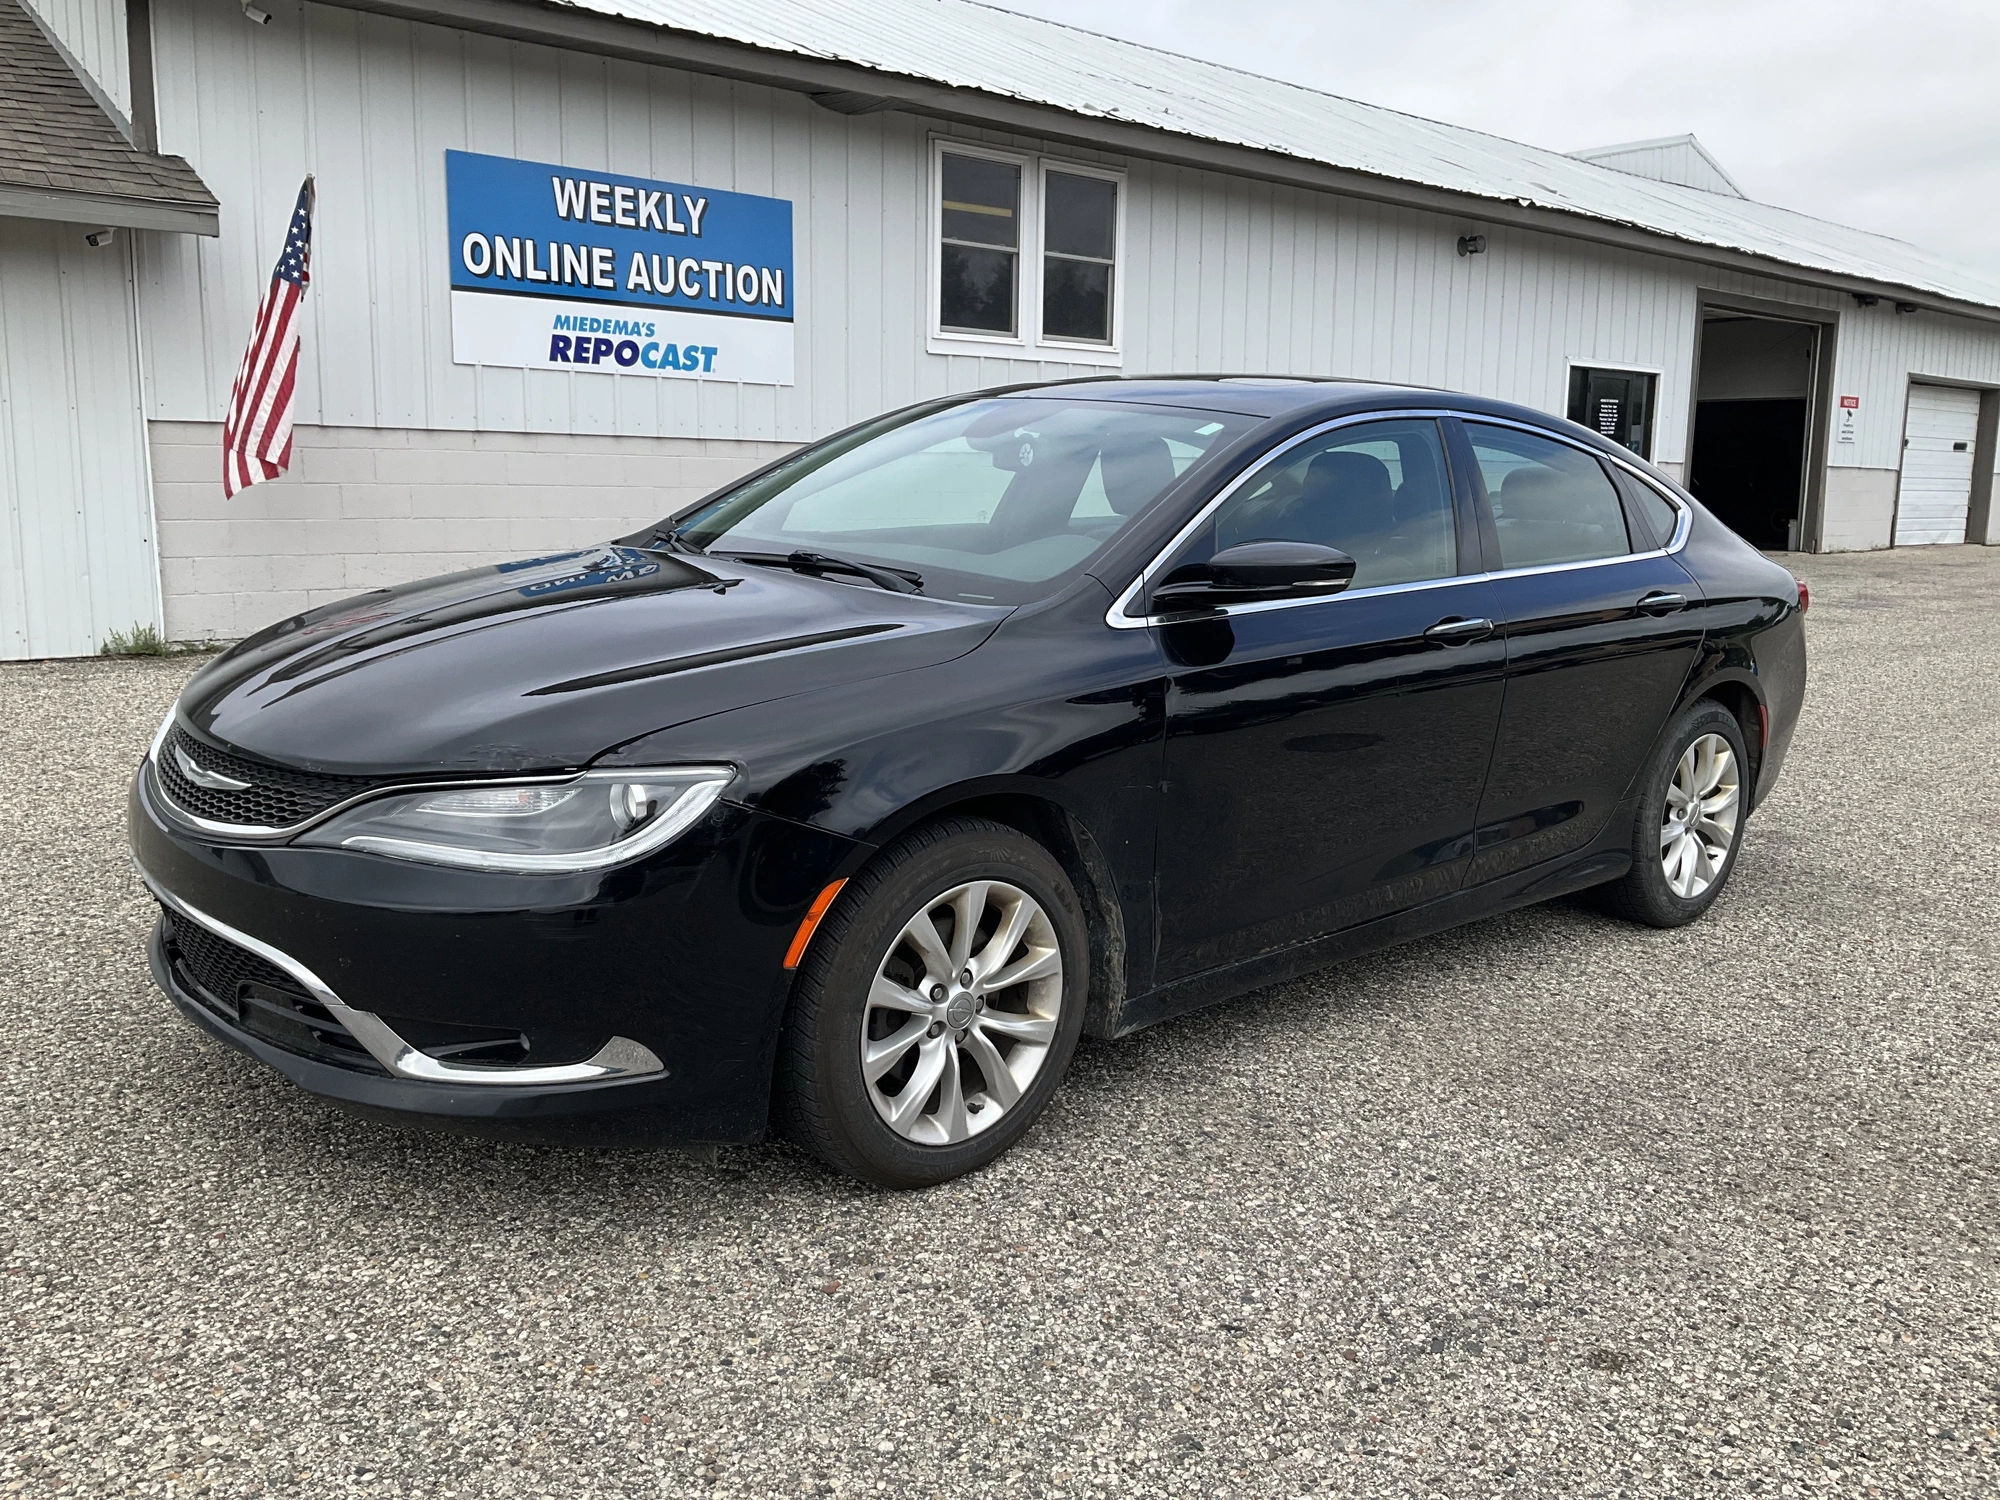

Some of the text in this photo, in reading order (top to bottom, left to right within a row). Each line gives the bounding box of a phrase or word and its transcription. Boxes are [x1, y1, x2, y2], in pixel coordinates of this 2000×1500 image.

[552, 176, 708, 236] WEEKLY
[462, 231, 784, 306] ONLINE AUCTION
[552, 314, 656, 337] MIEDEMA'S
[549, 334, 718, 373] REPOCAST
